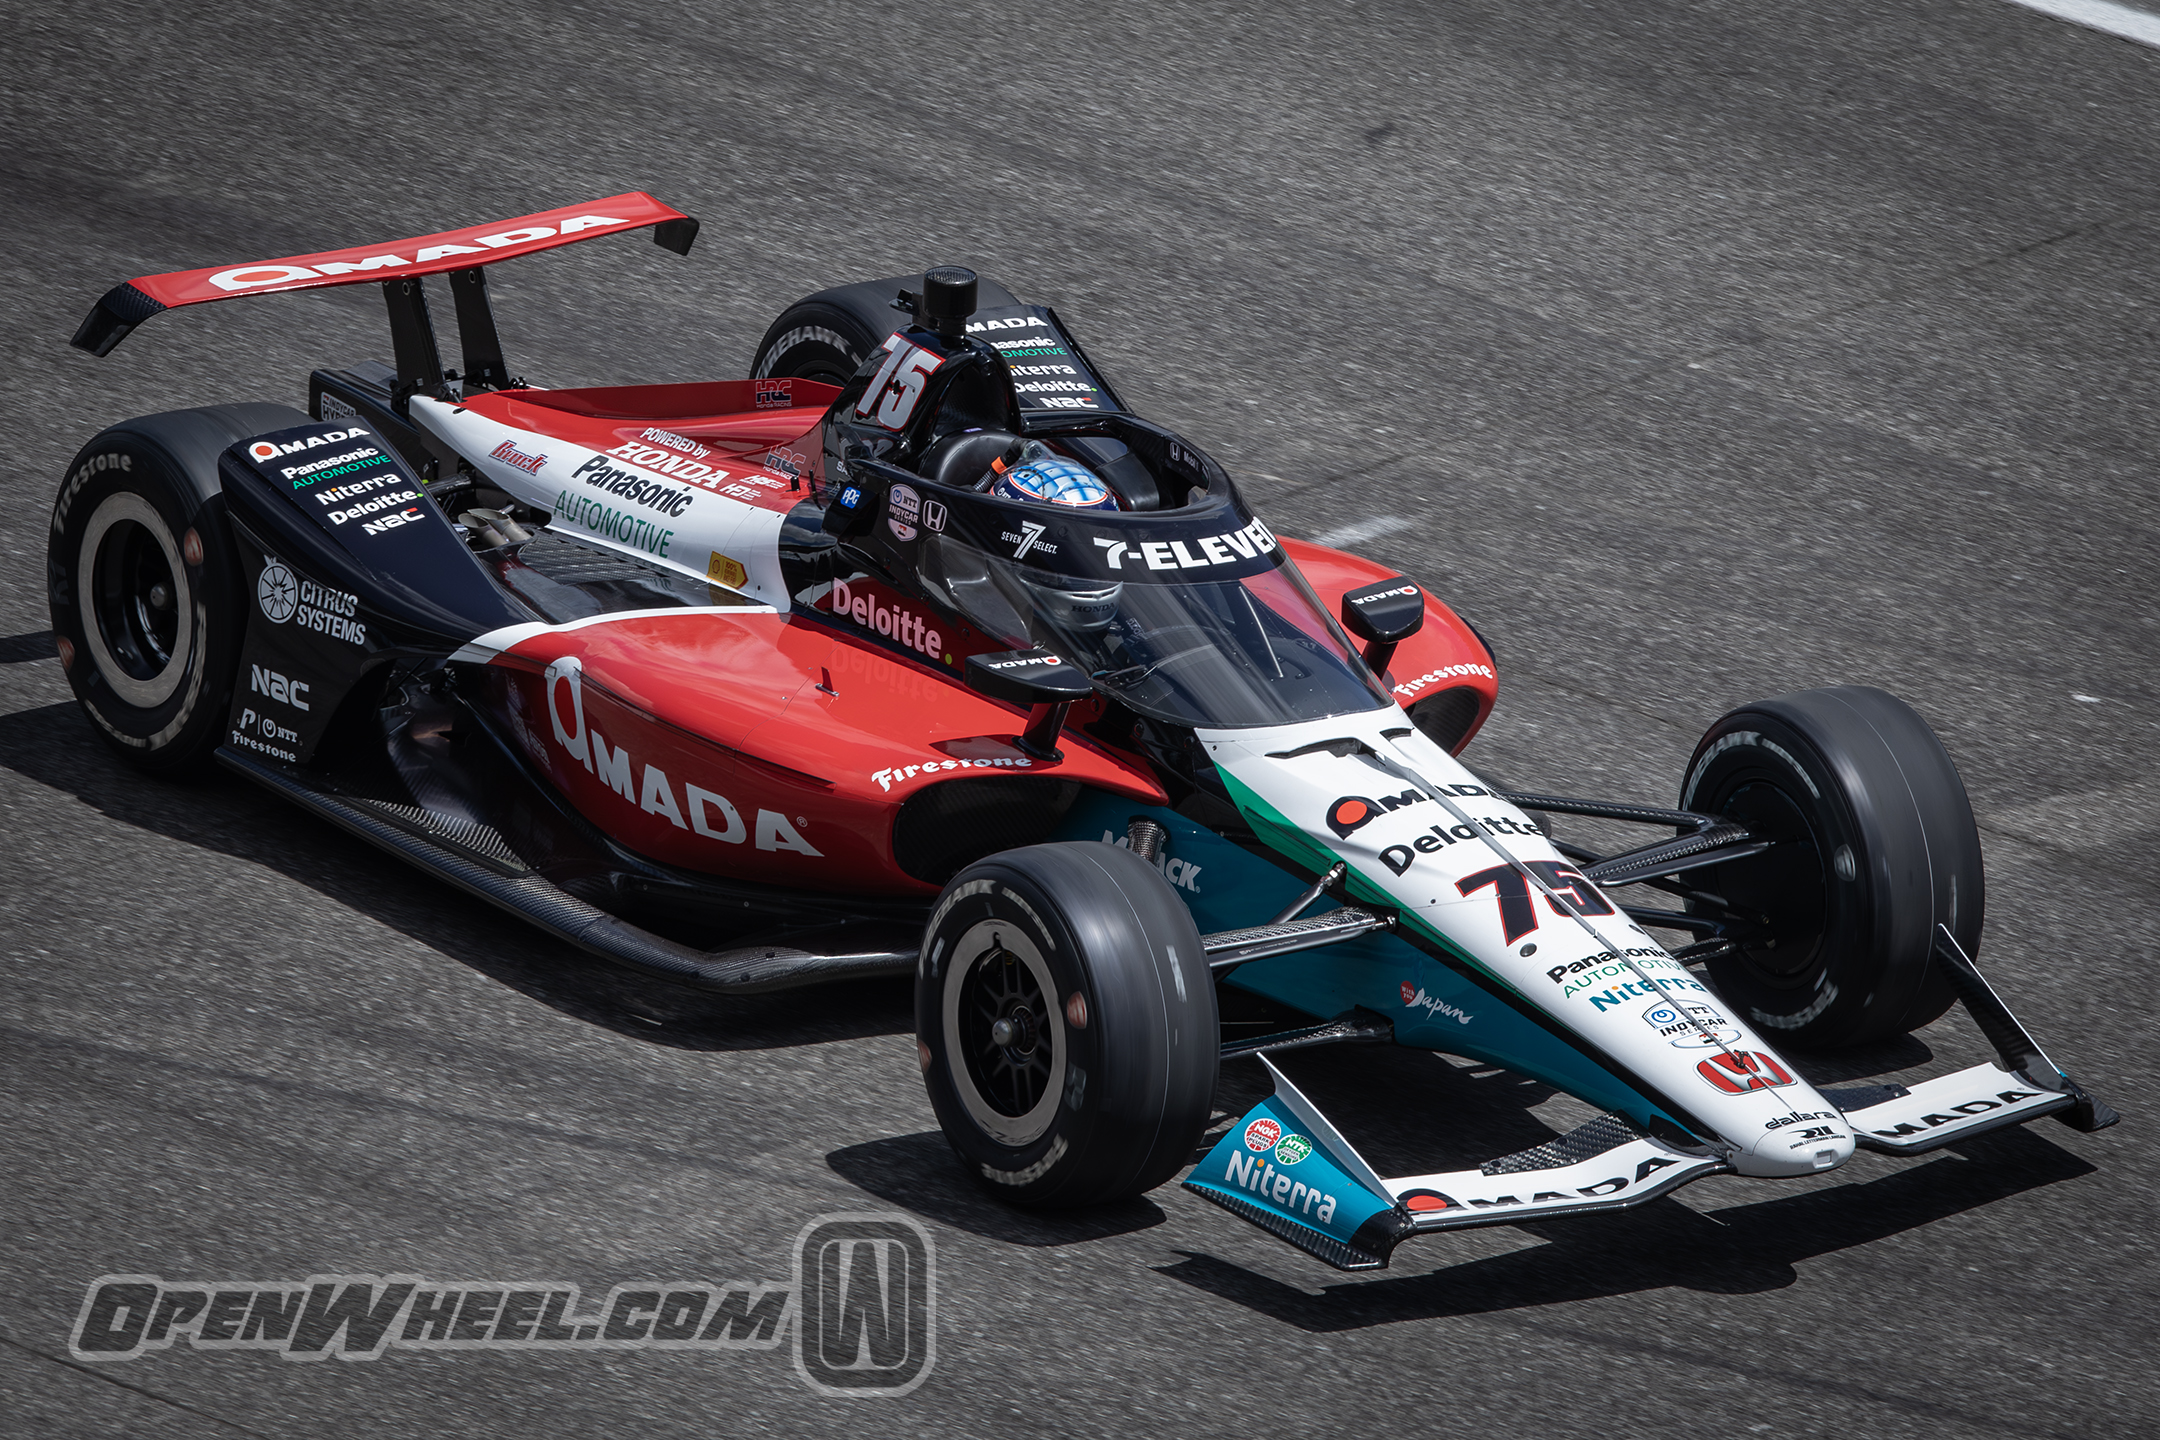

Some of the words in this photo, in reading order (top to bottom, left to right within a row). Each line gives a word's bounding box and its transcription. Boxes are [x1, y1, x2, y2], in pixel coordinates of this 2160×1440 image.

[208, 215, 630, 292] AMADA
[966, 316, 1048, 333] MADA
[1000, 348, 1068, 358] OMOTIVE
[856, 332, 946, 433] 75
[1010, 365, 1077, 377] iterra
[249, 427, 371, 464] AMADA
[640, 427, 694, 451] POWERED
[690, 441, 711, 459] by
[280, 447, 379, 480] Panasonic
[293, 454, 392, 490] AUTOMOTIVE
[606, 441, 730, 489] HONDA
[54, 453, 132, 535] Firestone
[314, 473, 402, 506] Niterra
[571, 455, 694, 518] Panasonic
[842, 488, 860, 506] PPG
[902, 495, 918, 509] NTT
[553, 490, 674, 559] AUTOMOTIVE
[888, 504, 919, 524] INDYCAR
[1001, 531, 1022, 545] SEVEN
[300, 580, 359, 618] CITRUS
[1071, 602, 1115, 614] HONDA
[297, 604, 366, 646] SYSTEMS
[1392, 661, 1493, 697] Firestone
[231, 730, 297, 763] Firestone
[277, 727, 298, 743] NTT
[544, 656, 825, 858] AMADA
[871, 757, 1032, 792] Firestone
[1455, 860, 1616, 947] 75
[1546, 945, 1675, 985] Panaonic
[1588, 978, 1709, 1013] Niterra
[1684, 1006, 1710, 1015] TT
[1679, 1025, 1720, 1037] SERES
[1764, 1111, 1838, 1130] dallara
[1871, 1090, 2045, 1138] MADA
[1248, 1138, 1267, 1148] PLUGS
[1250, 1132, 1270, 1143] SPARK
[1253, 1123, 1278, 1139] NGK
[1285, 1138, 1308, 1153] NTK
[1225, 1149, 1337, 1225] Niterra
